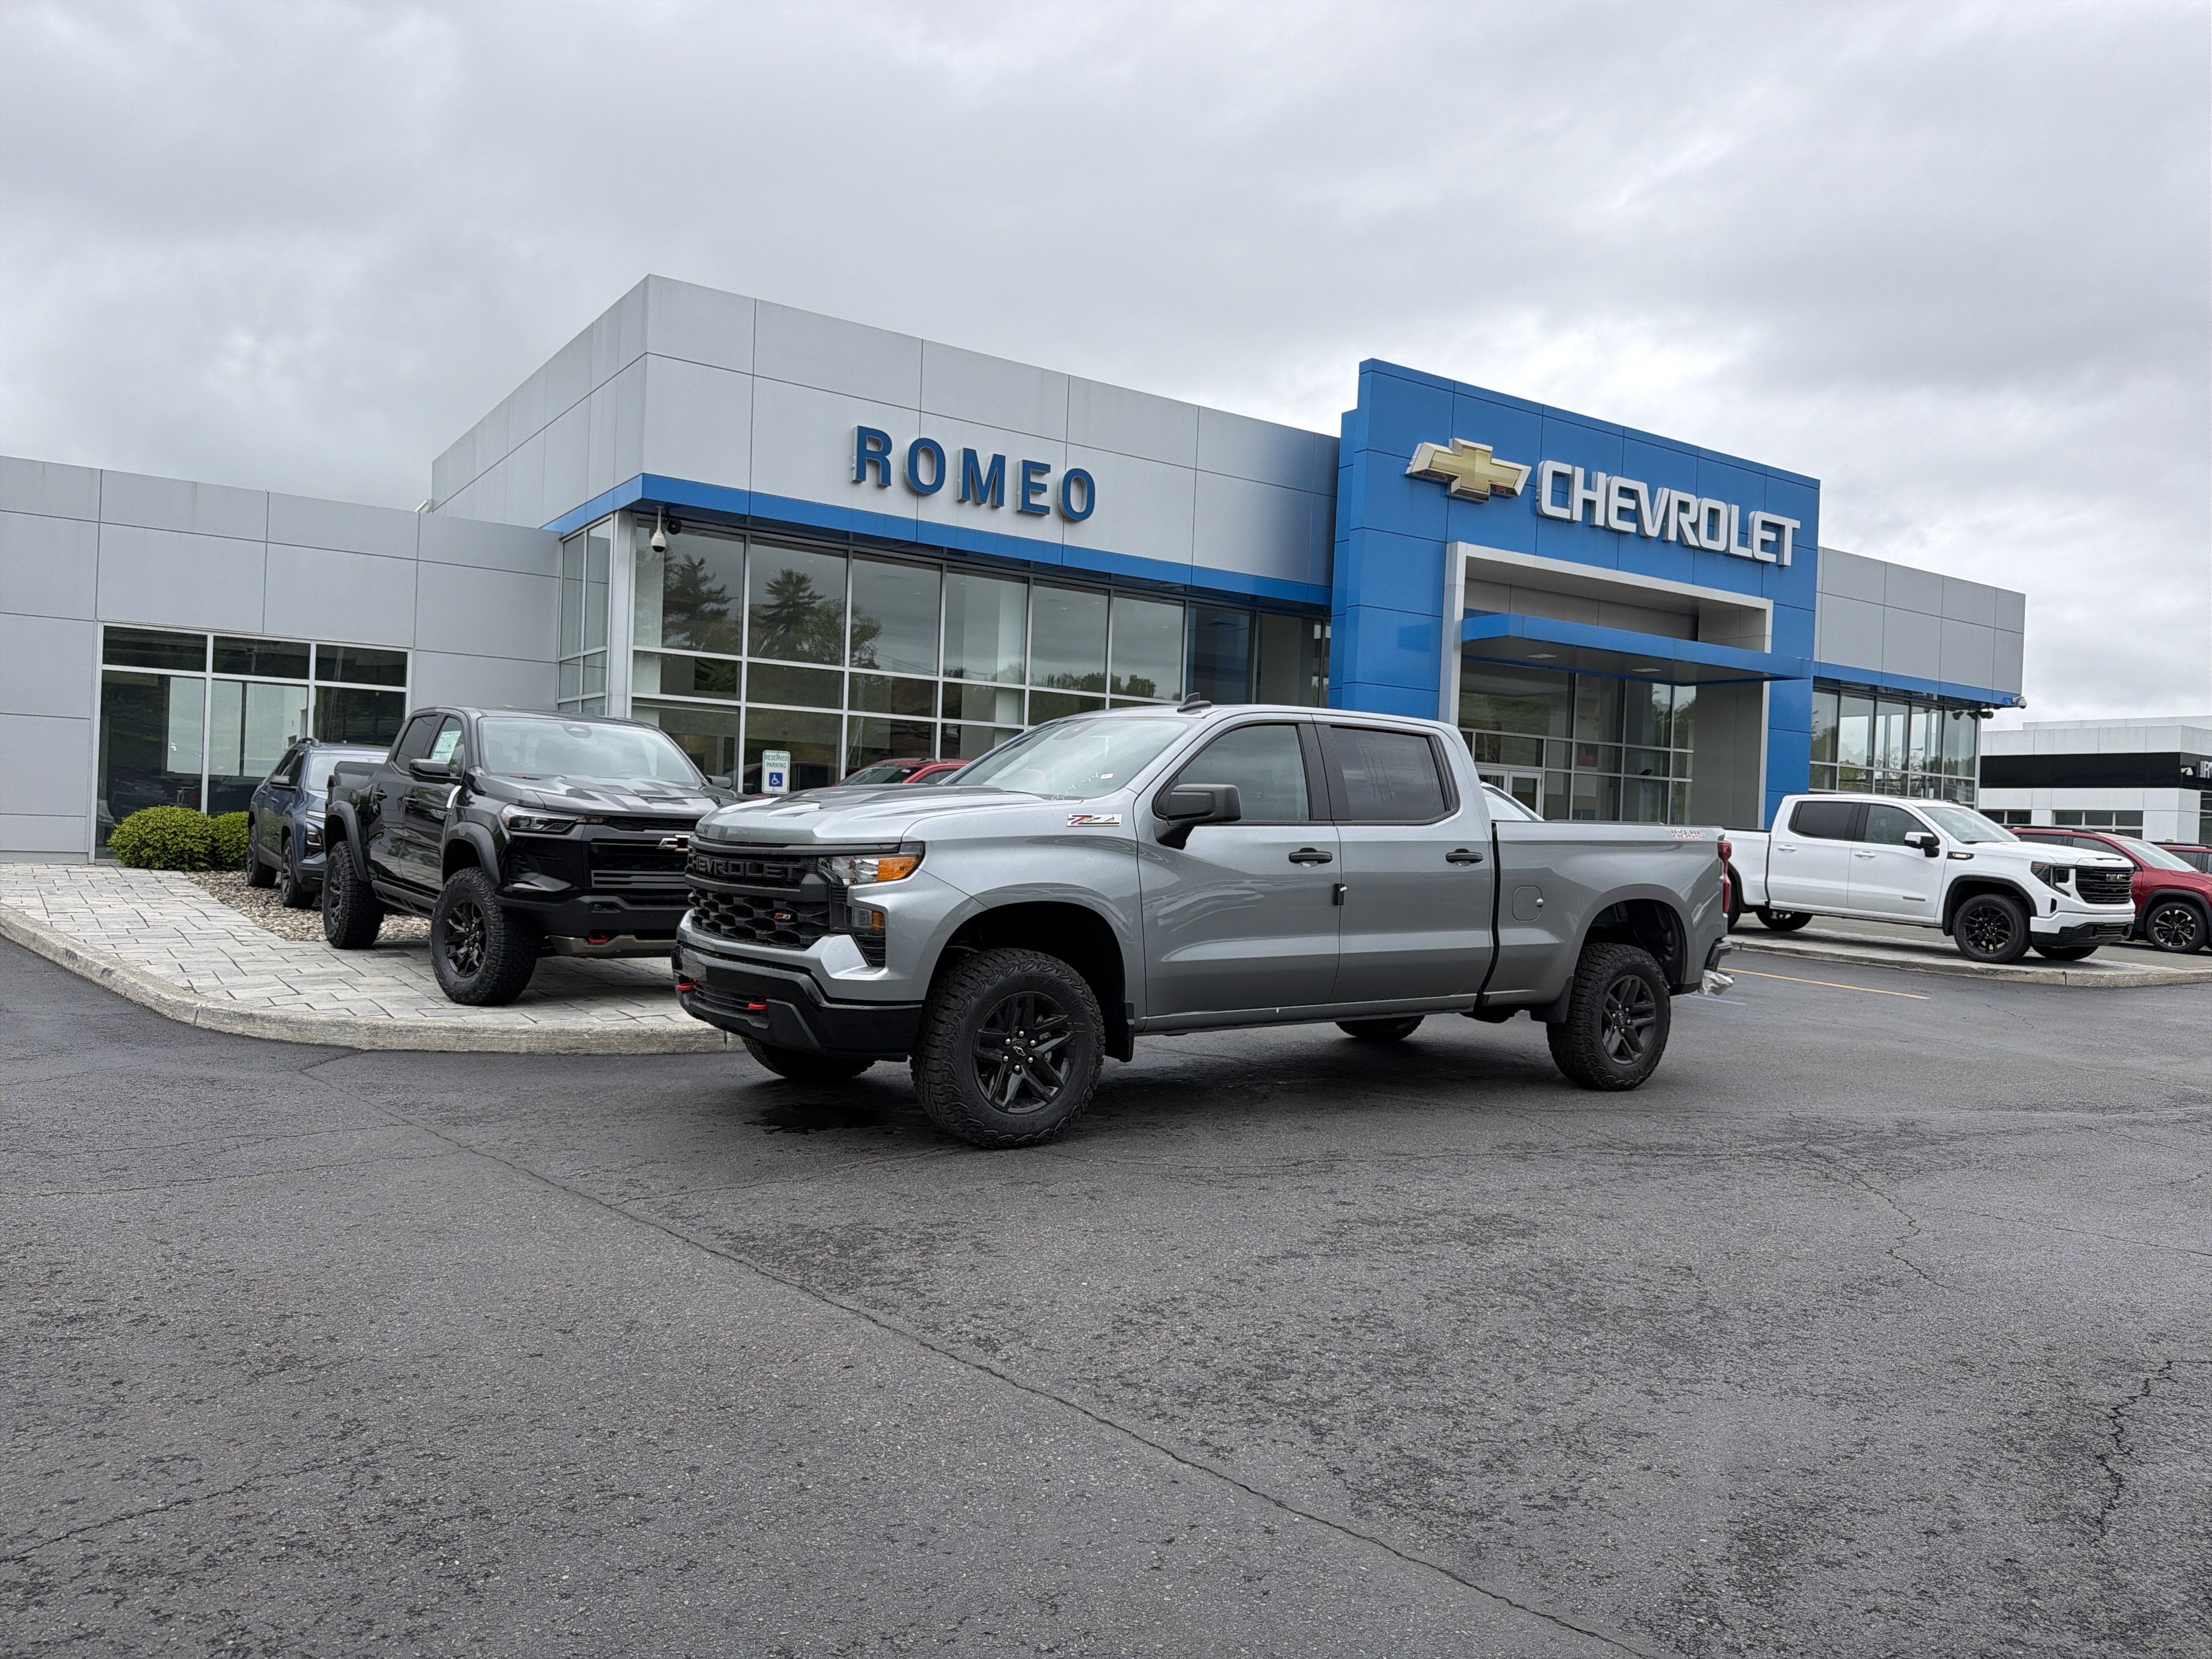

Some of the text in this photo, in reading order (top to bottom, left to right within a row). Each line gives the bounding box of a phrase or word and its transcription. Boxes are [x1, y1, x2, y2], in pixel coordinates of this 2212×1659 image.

[851, 425, 1096, 522] ROMEO
[1536, 460, 1801, 566] CHEVROLET
[1067, 814, 1122, 827] Z71
[687, 852, 802, 881] CHEVROLET
